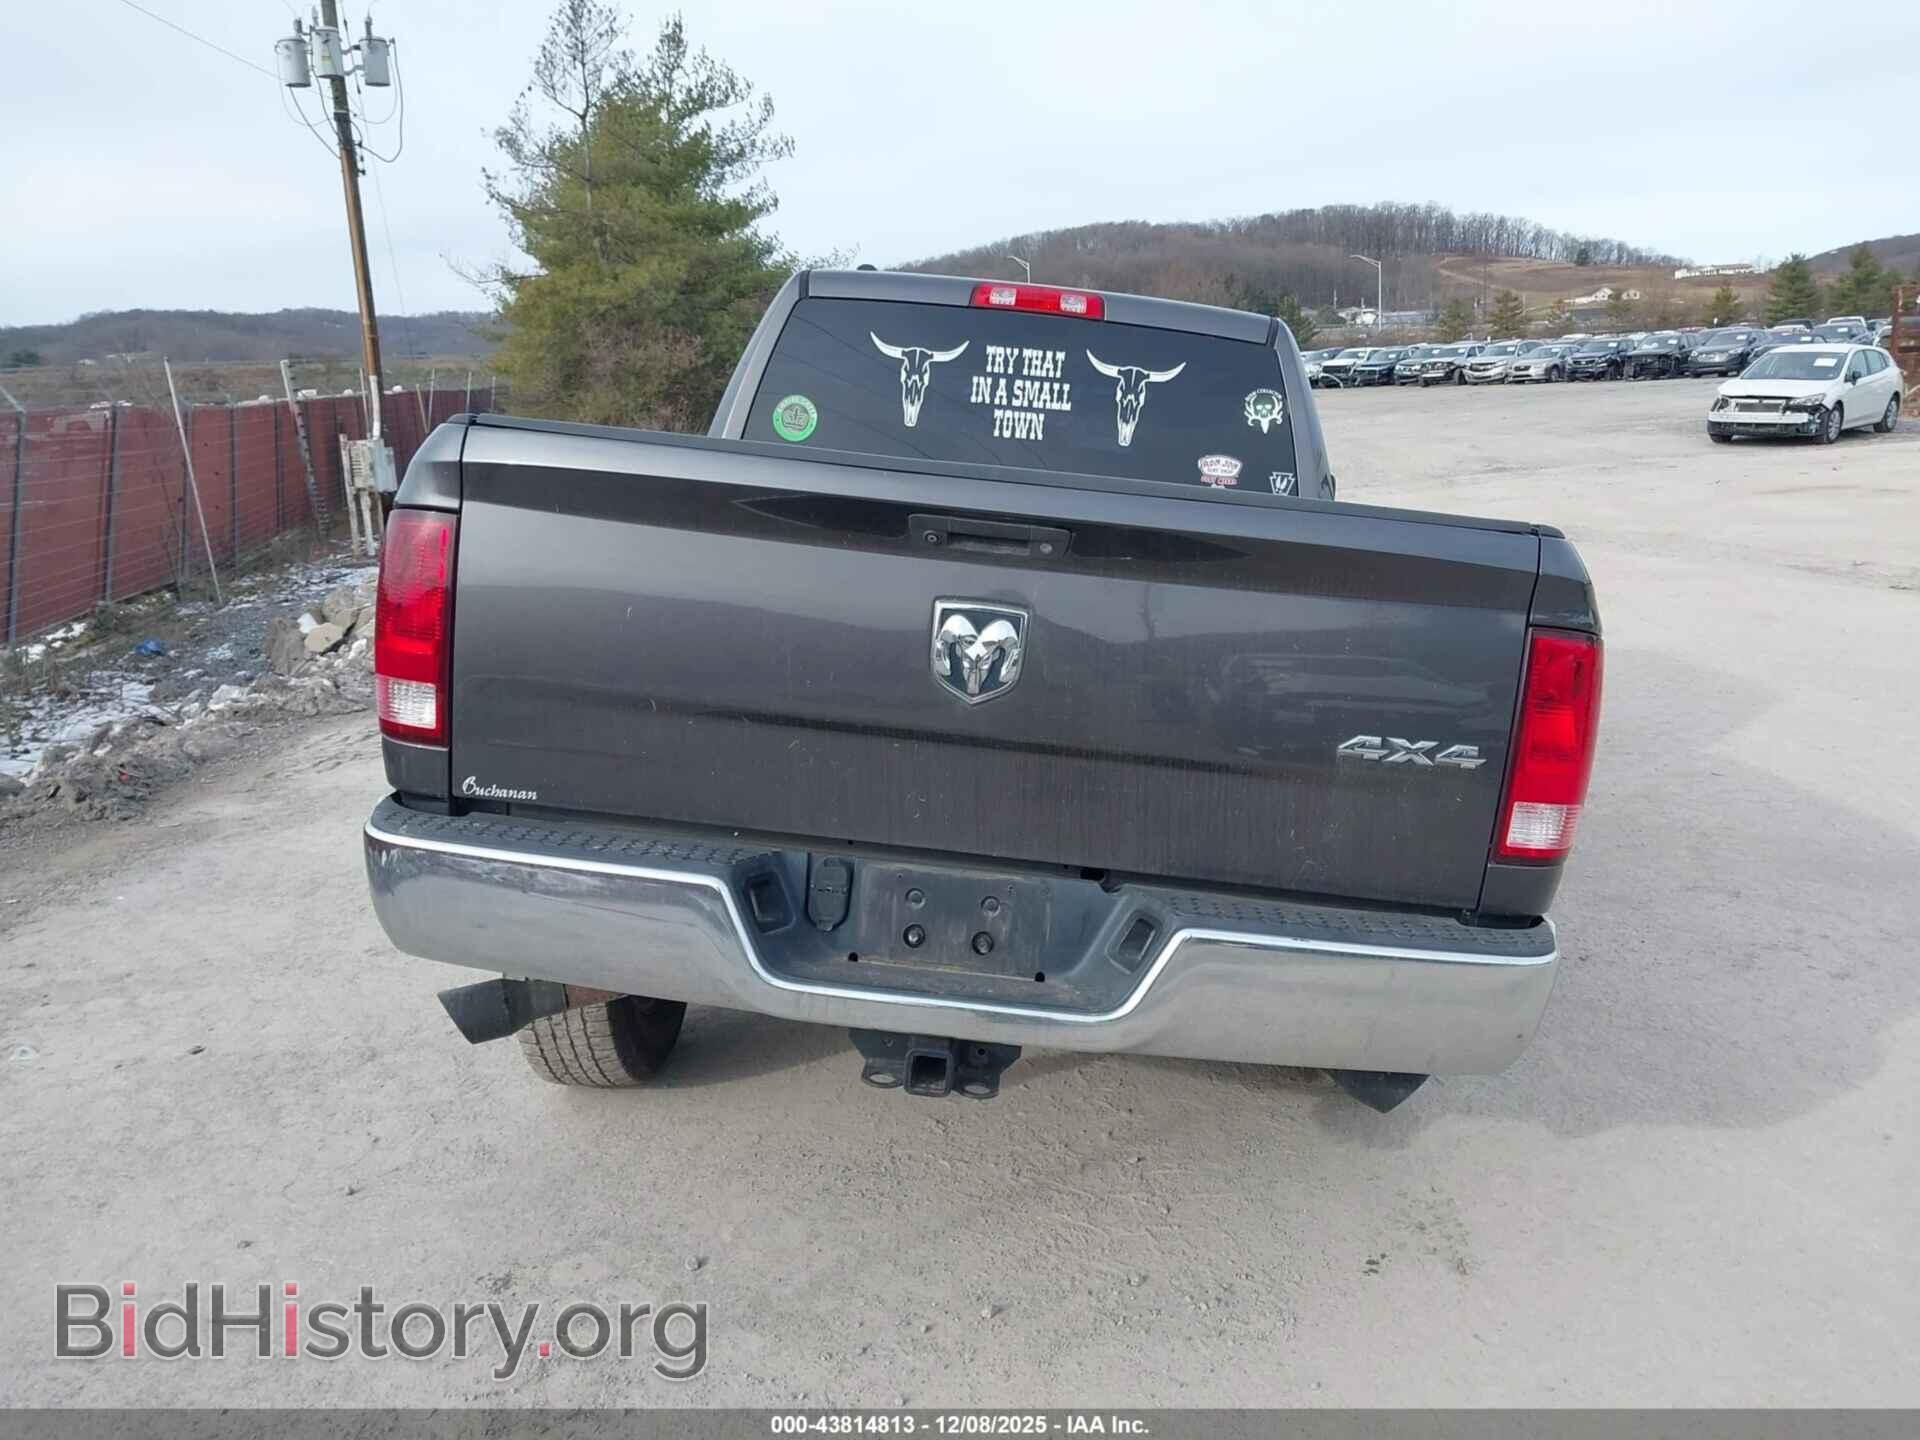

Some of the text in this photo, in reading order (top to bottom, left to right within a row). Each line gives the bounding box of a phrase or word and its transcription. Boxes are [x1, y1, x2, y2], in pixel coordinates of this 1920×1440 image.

[986, 344, 1066, 378] TRY THAT
[970, 375, 1072, 411] IN A SMALL
[993, 408, 1045, 441] TOWN
[462, 775, 538, 800] Buchanan
